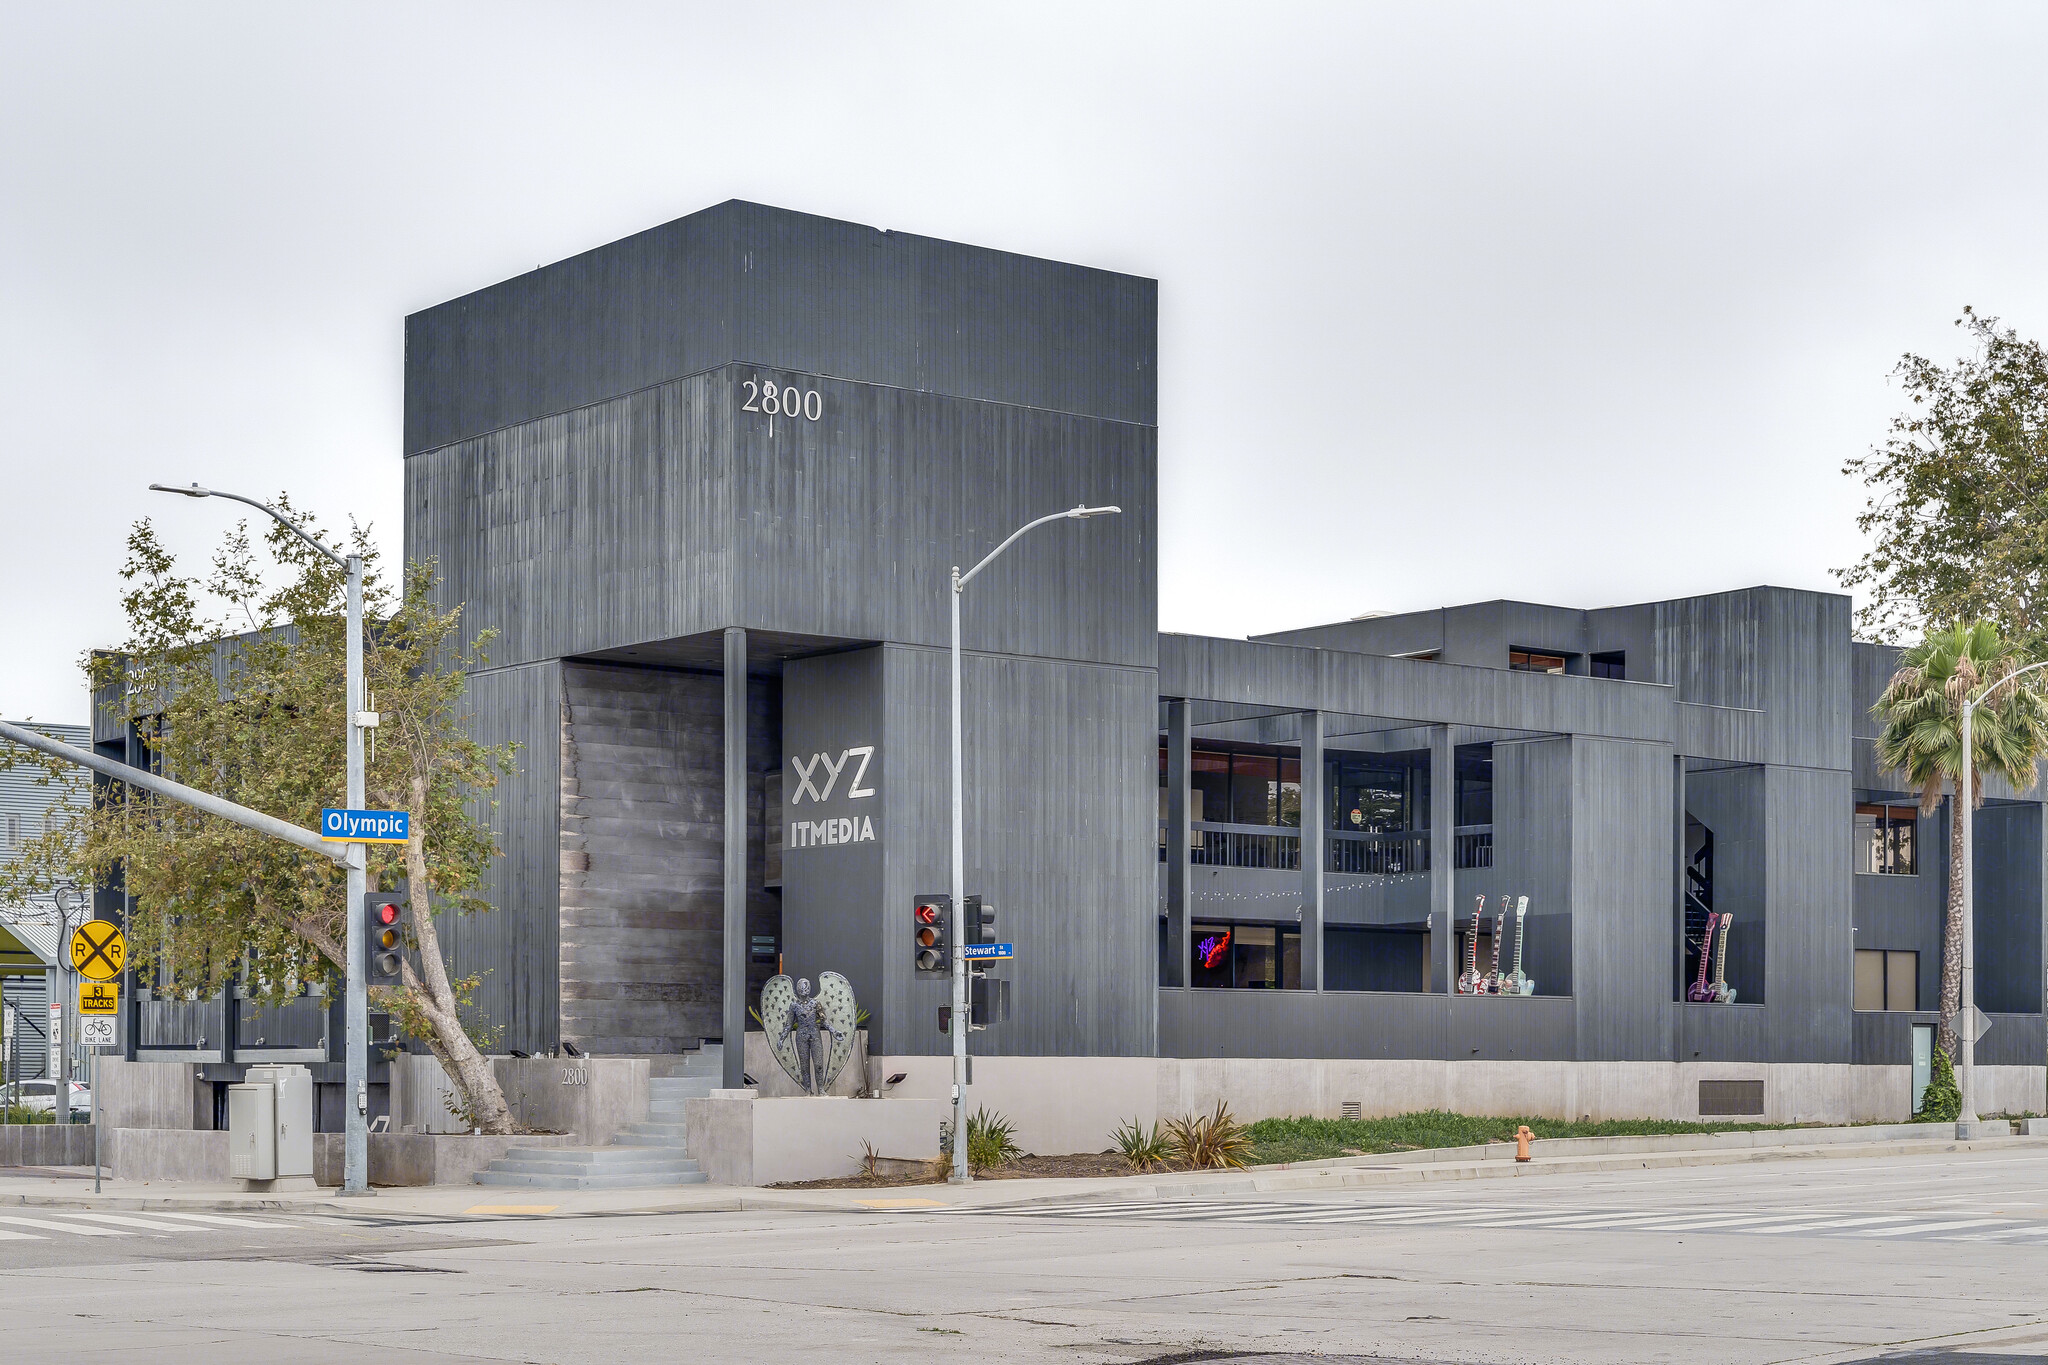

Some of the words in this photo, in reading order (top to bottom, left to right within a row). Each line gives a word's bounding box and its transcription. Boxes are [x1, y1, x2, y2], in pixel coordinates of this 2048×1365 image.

[742, 380, 822, 421] 2800
[792, 746, 875, 805] XYZ
[327, 812, 403, 837] Olympic
[791, 815, 876, 847] ITMEDIA
[75, 943, 86, 957] R
[111, 944, 121, 958] R
[965, 945, 996, 956] Stewart
[95, 987, 102, 997] 3
[83, 999, 114, 1008] TRACKS
[561, 1067, 588, 1085] 2800
